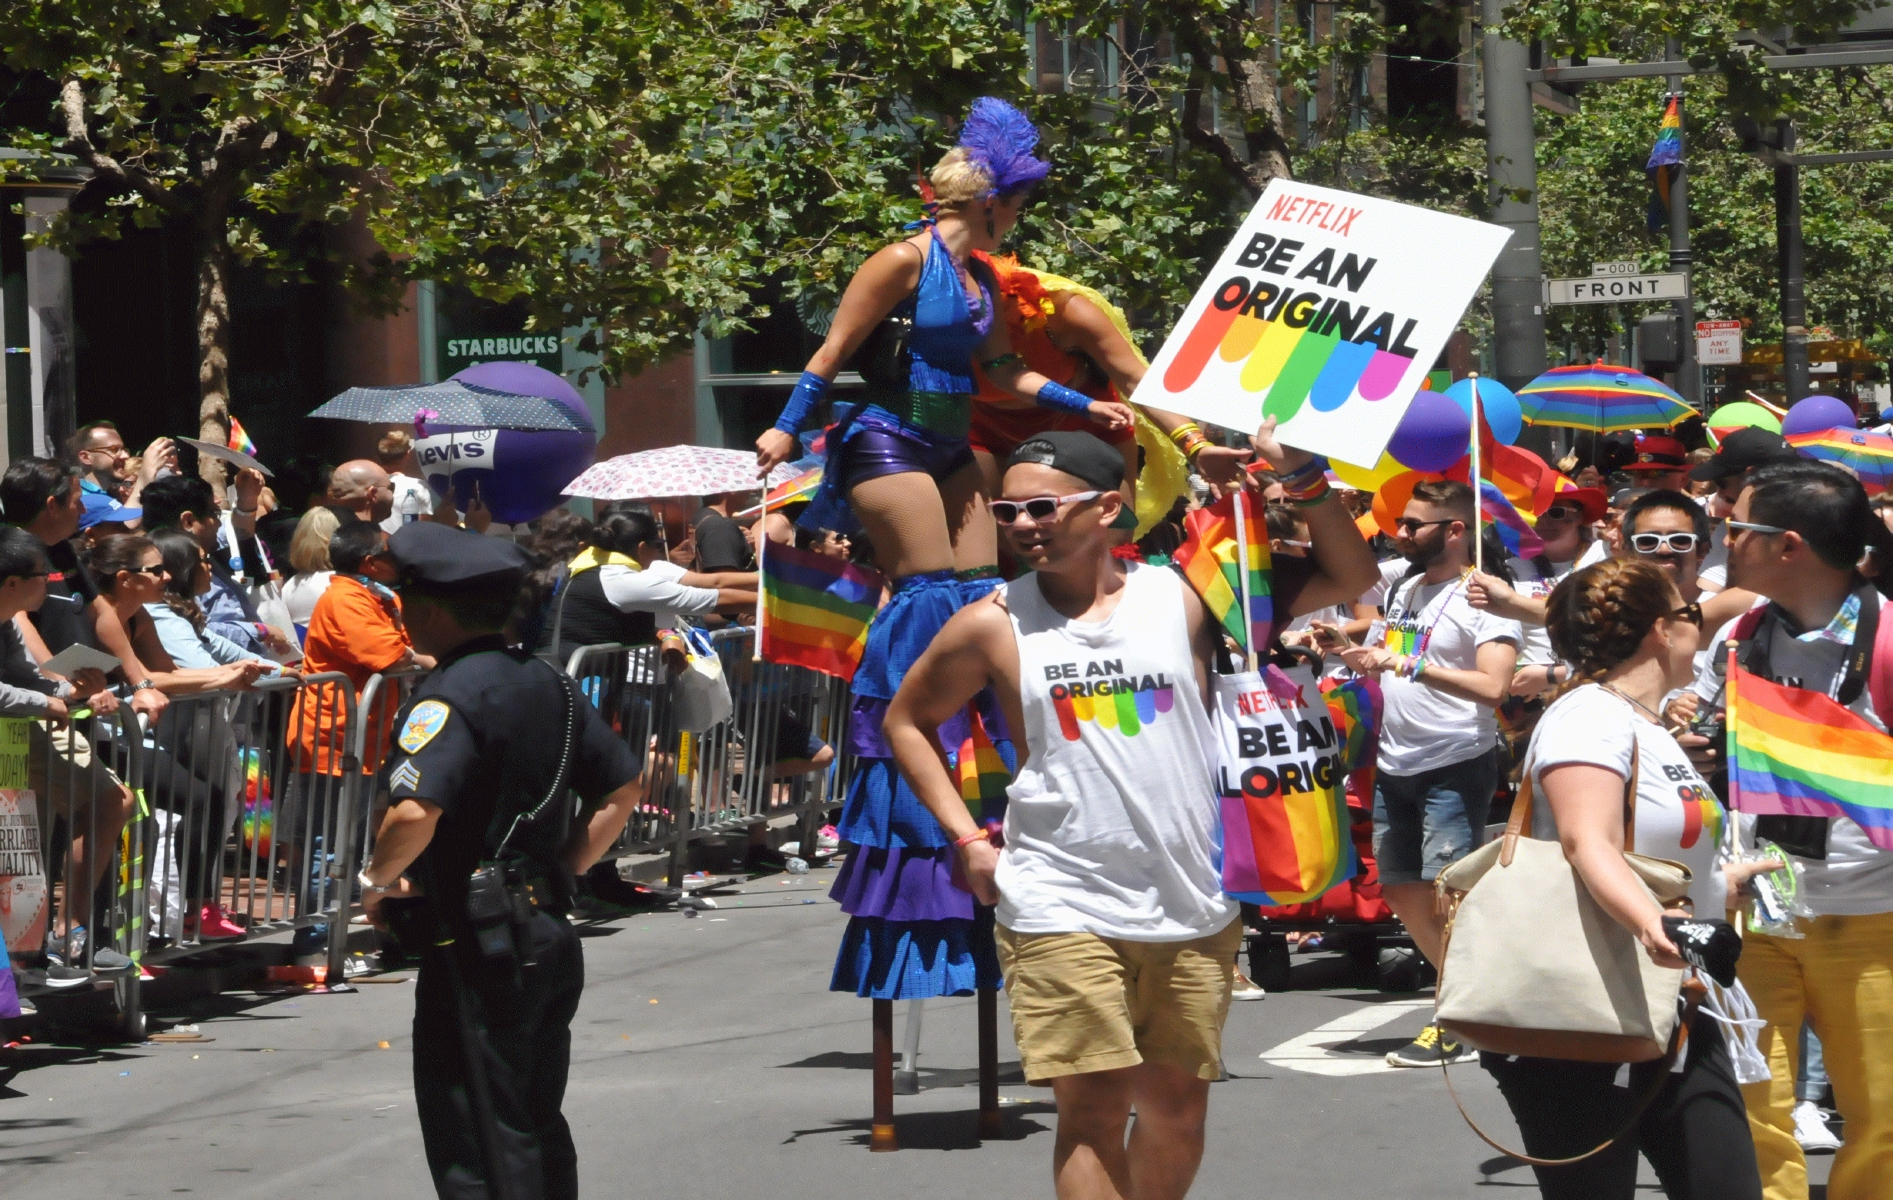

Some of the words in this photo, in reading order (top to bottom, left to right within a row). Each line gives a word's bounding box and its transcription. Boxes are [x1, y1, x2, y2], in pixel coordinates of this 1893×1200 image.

[1265, 194, 1363, 237] NETFLIX
[1235, 232, 1305, 275] BE
[1294, 247, 1378, 293] AN
[1574, 280, 1659, 298] FRONT
[1213, 275, 1419, 360] ORIGINAL
[1698, 329, 1710, 338] NO
[447, 336, 558, 357] STARBUCKS
[1043, 663, 1079, 681] BE
[1085, 659, 1124, 677] AN
[1049, 673, 1173, 700] ORIGINAL
[1237, 723, 1291, 758] BE
[1662, 764, 1694, 781] BE
